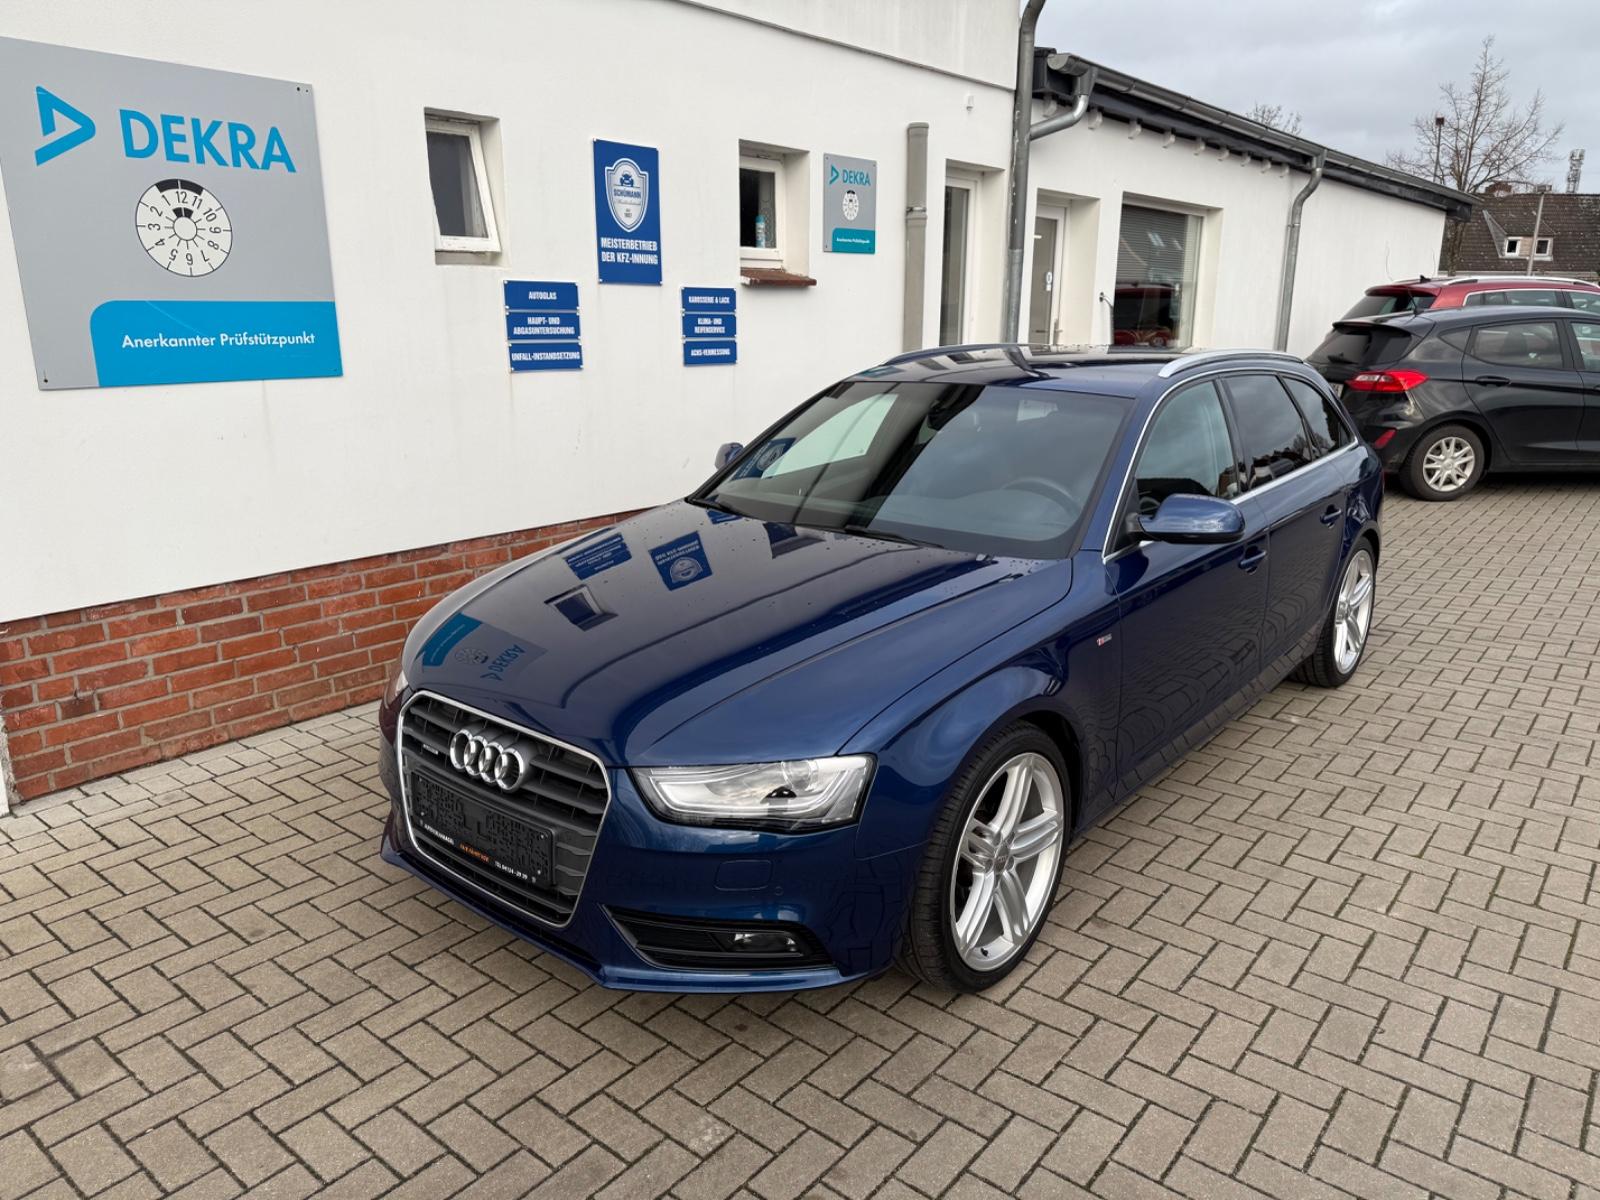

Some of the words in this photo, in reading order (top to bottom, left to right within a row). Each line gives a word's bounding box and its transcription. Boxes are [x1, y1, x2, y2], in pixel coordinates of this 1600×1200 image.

[120, 109, 297, 173] DEKRA
[842, 169, 871, 186] DEKRA
[161, 194, 171, 206] 1
[175, 191, 189, 204] 12
[191, 195, 203, 209] 11
[149, 206, 163, 217] 2
[203, 208, 218, 222] 10
[147, 223, 161, 231] 3
[209, 226, 222, 234] 9
[154, 238, 165, 247] 4
[207, 240, 220, 250] 8
[601, 237, 658, 251] MEISTERBETRIEB
[169, 249, 178, 261] 5
[185, 253, 194, 265] 6
[200, 250, 210, 262] 7
[601, 251, 616, 262] DER
[616, 252, 659, 265] KFZ-INNUNG
[528, 291, 557, 300] AUTOGLAS
[719, 296, 730, 304] LACK
[527, 316, 547, 325] HAUPT-
[548, 316, 560, 325] UND
[513, 326, 576, 335] ABGASUNTERSUCHUNG
[694, 326, 725, 334] REIFENSERVICE
[122, 333, 215, 349] Anerkannter
[220, 331, 316, 348] Prüfstützpunkt
[511, 351, 581, 361] UNFALL-INSTANDSETZUNG
